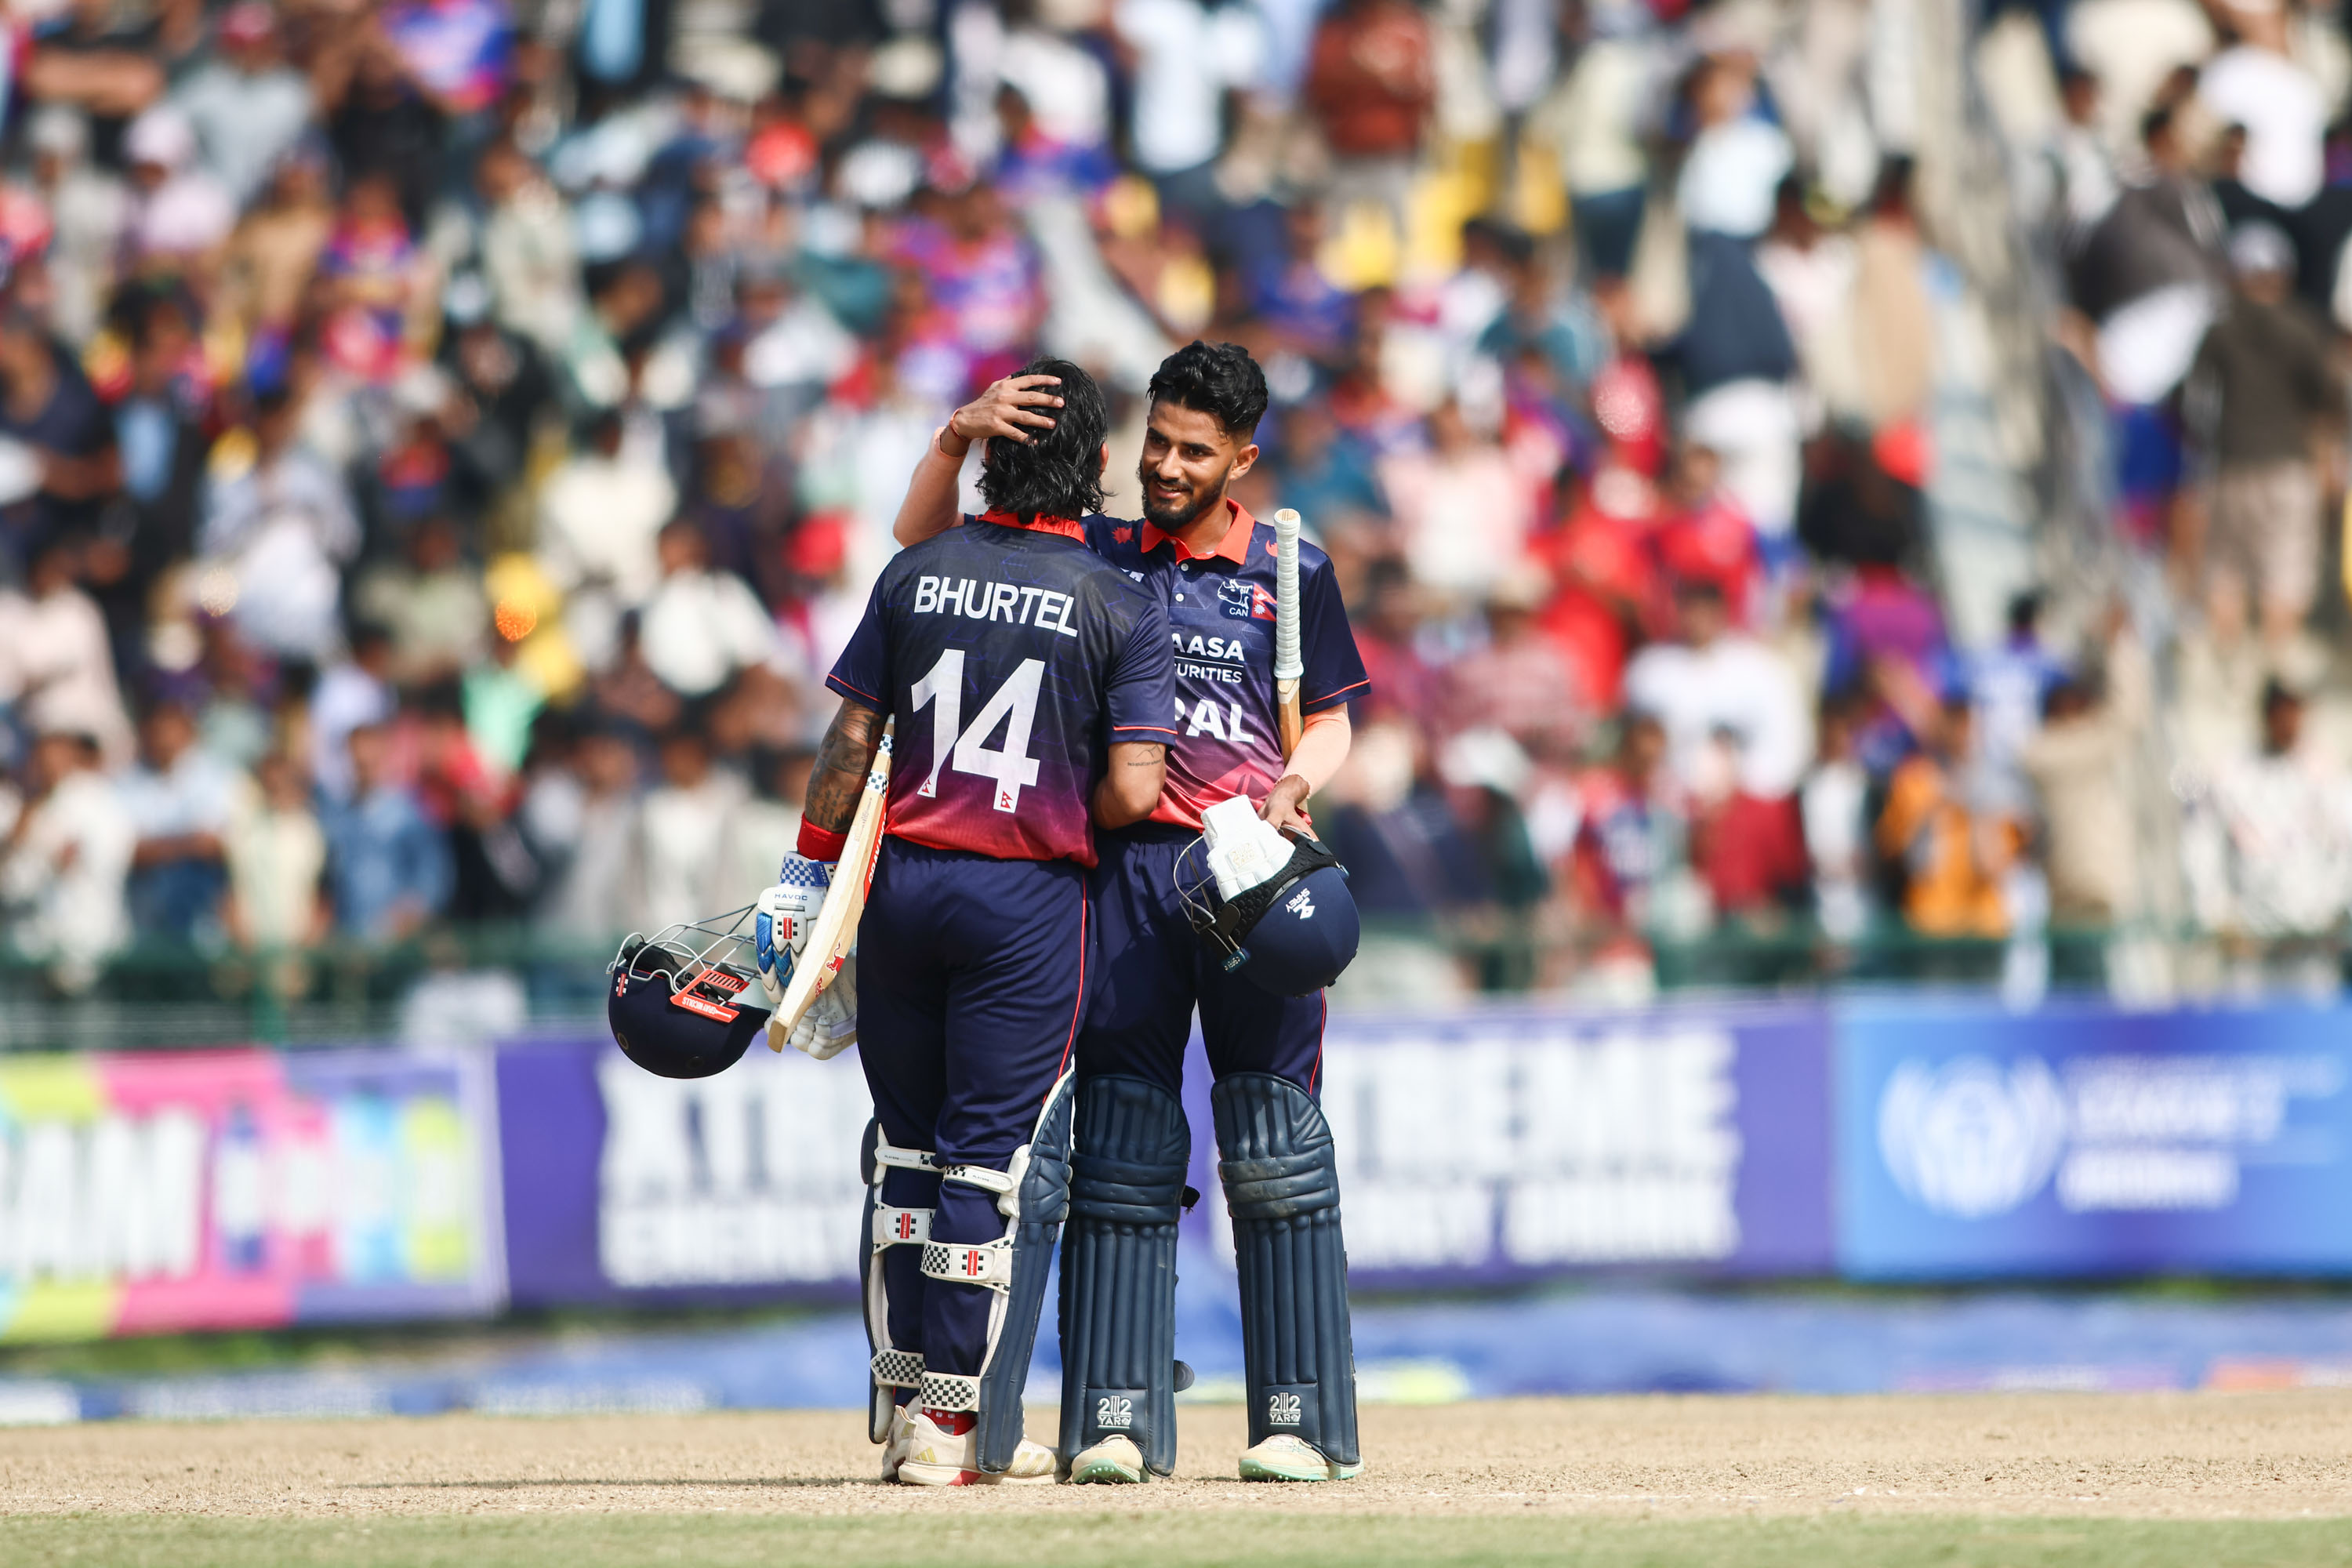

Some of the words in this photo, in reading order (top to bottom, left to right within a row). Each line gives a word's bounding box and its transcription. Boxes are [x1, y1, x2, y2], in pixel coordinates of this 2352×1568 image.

[913, 575, 1079, 637] BHURTEL
[1229, 607, 1249, 617] CAN
[1174, 662, 1243, 684] URITIES
[910, 648, 1046, 814] 14
[1285, 887, 1312, 914] SHREY
